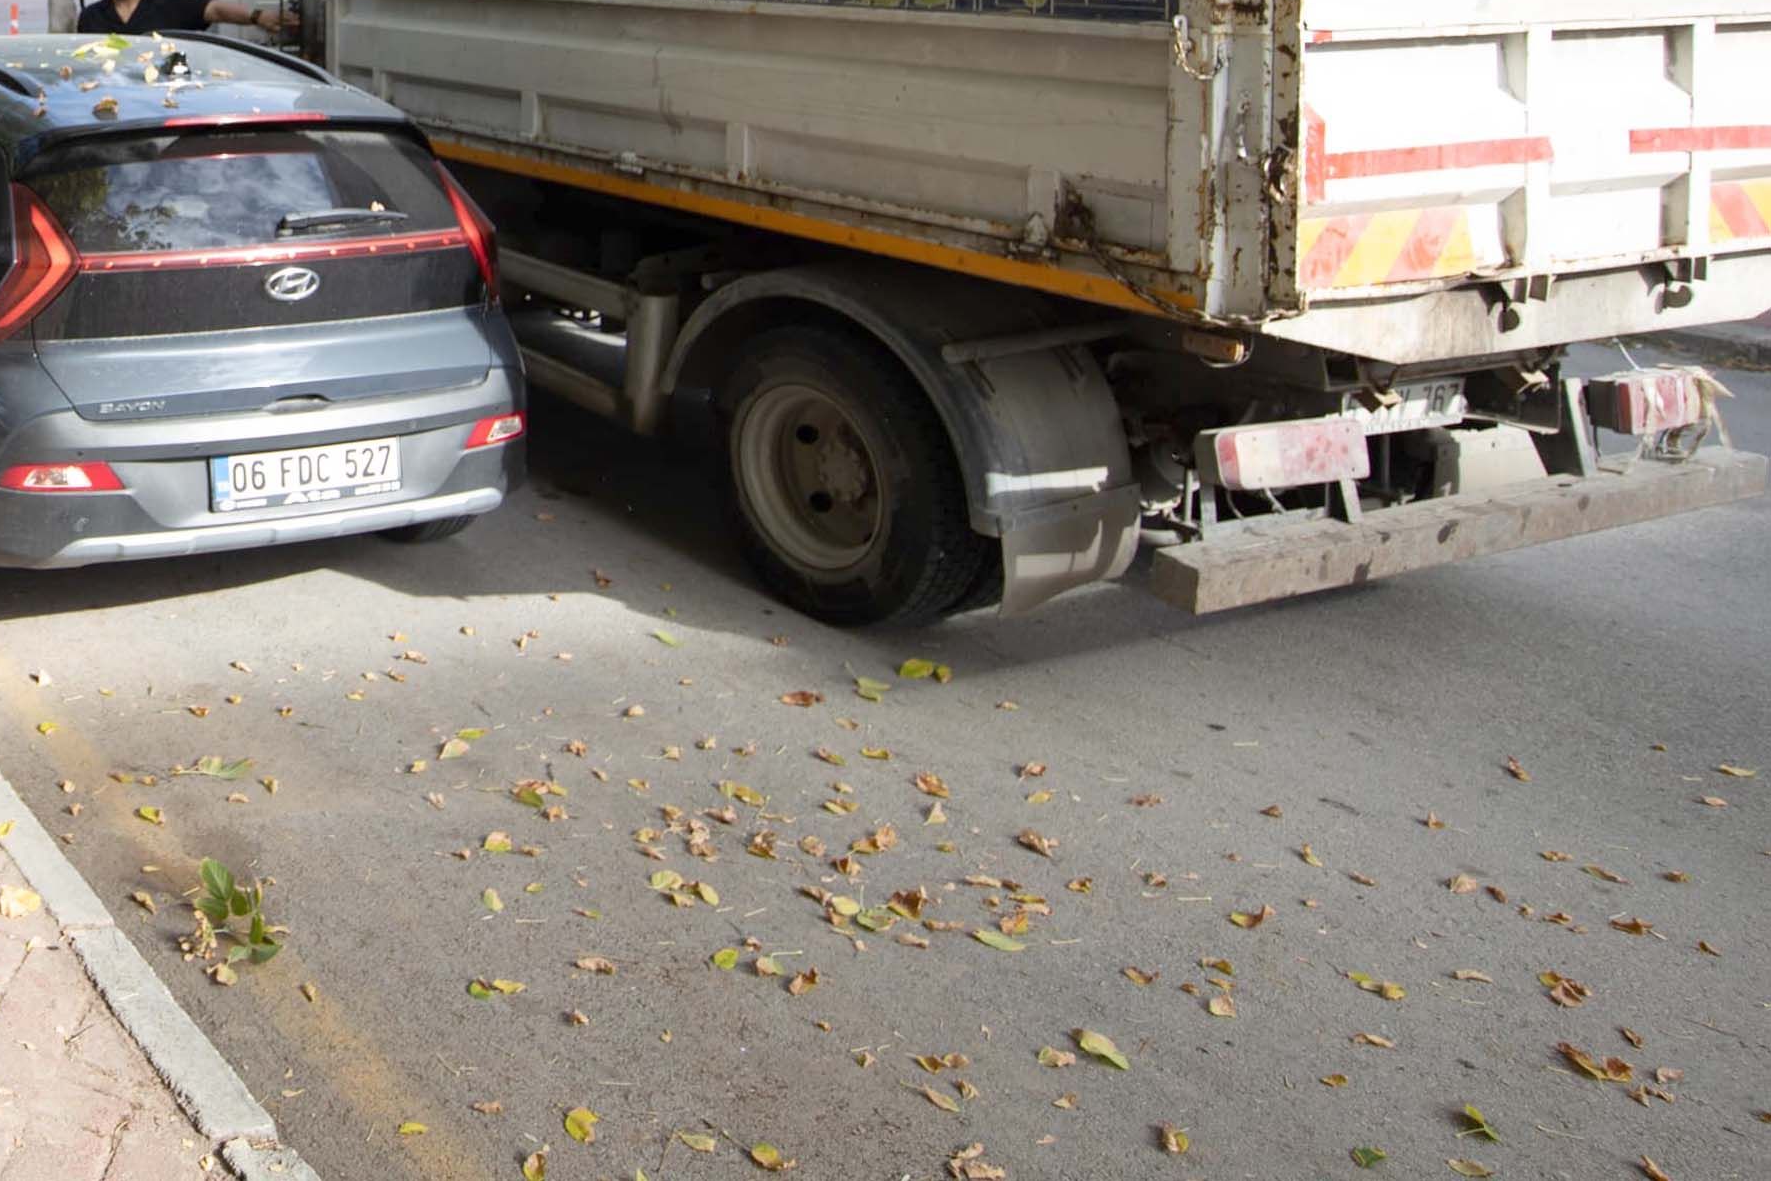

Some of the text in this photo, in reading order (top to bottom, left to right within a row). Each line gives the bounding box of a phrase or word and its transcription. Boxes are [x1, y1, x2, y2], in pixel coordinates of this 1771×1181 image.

[233, 460, 266, 493] 06
[280, 453, 330, 488] FDC
[345, 445, 391, 479] 527
